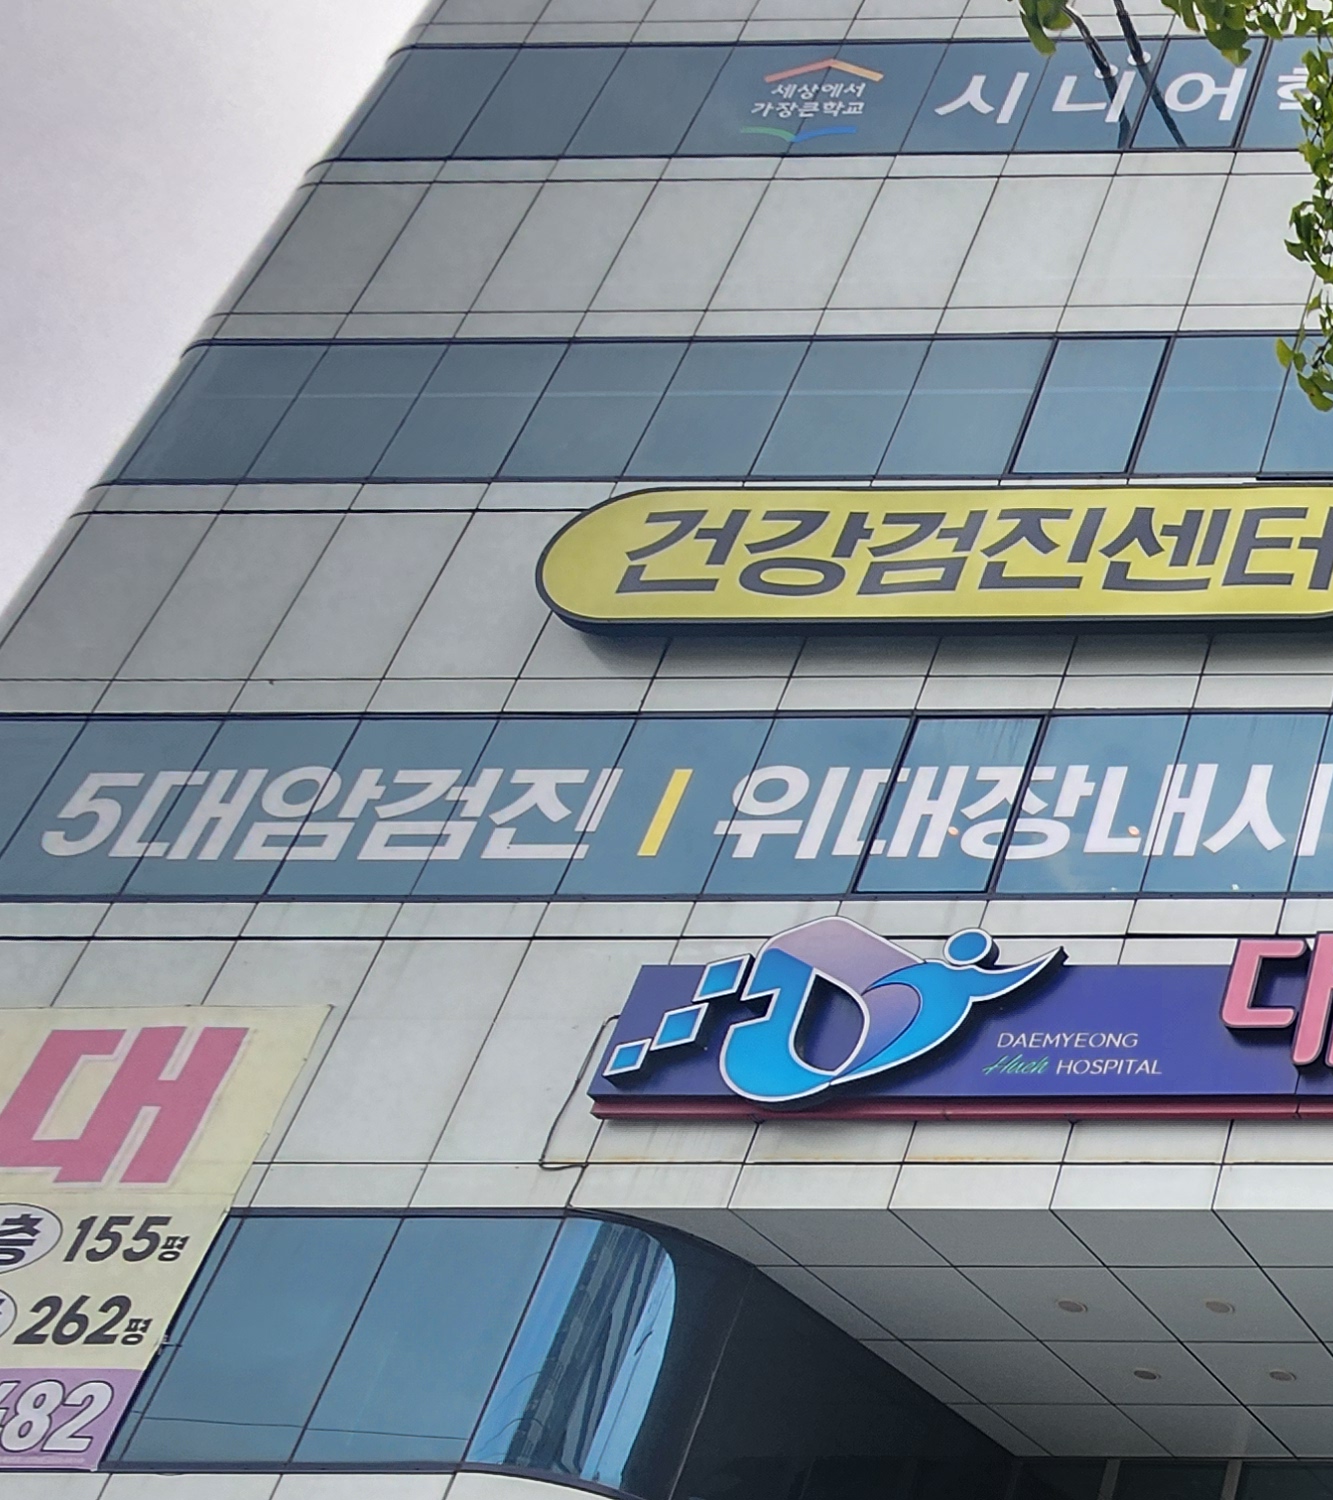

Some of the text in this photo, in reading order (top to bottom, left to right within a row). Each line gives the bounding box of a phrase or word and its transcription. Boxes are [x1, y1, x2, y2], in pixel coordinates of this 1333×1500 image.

[771, 82, 866, 99] 세상에서
[751, 101, 865, 118] 가장큰학교
[41, 765, 623, 861] 5대암검진
[997, 1032, 1139, 1049] DAEMYEONG
[1056, 1058, 1162, 1075] HOSPITAL
[62, 1214, 190, 1263] 155평
[13, 1294, 153, 1345] 262평
